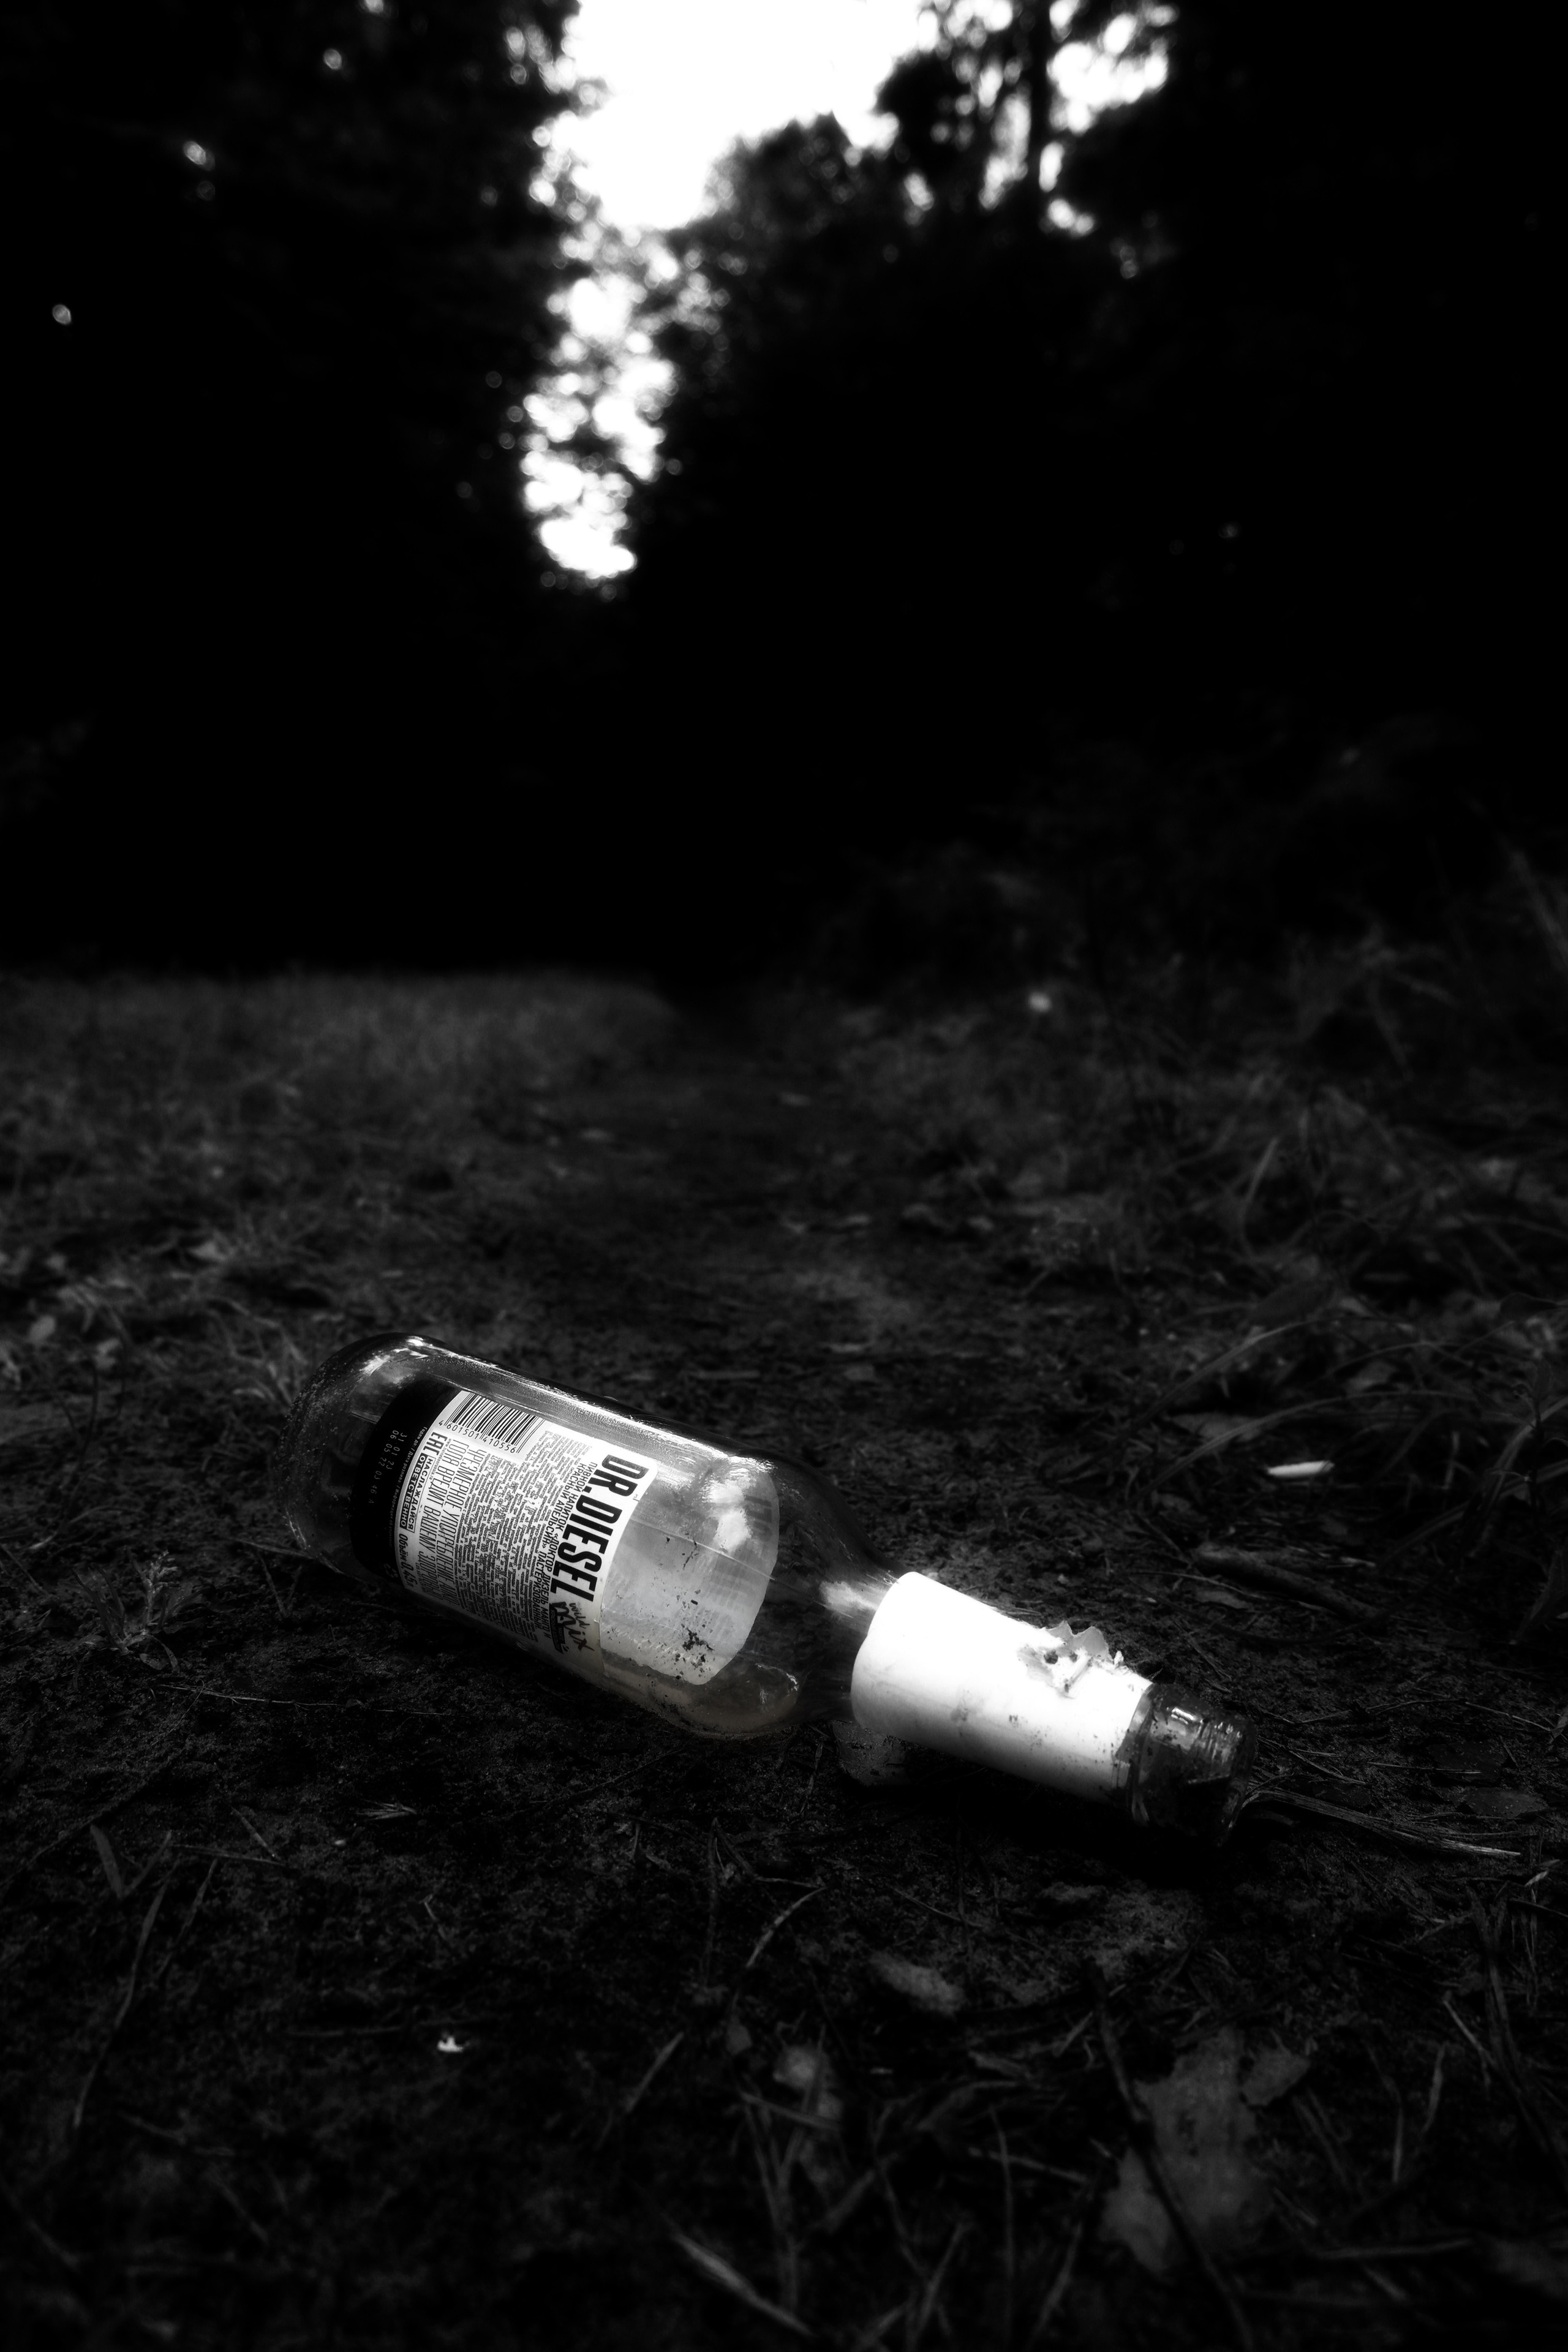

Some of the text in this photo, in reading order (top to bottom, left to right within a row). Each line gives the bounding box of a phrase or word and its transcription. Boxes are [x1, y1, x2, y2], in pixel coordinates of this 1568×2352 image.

[445, 1422, 480, 1440] 601501
[481, 1434, 518, 1454] 410556
[400, 1454, 426, 1527] ОТВЕТСТВЕННО
[407, 1458, 434, 1530] НАСЛАЖДАЙСЯ
[559, 1462, 587, 1499] КРАСНЫЙ
[572, 1461, 600, 1493] ПИВНОЙ
[418, 1439, 469, 1600] ГОЛЯ ВРЕДИТ ВАШЕМУ ЗДОРОВЬЮ
[435, 1445, 486, 1608] ЧРЕЗМЕРНОЕ УПОТРЕБЛЕНИЕ АЛКО-
[540, 1499, 565, 1550] АПЕЛЬСИН»
[555, 1492, 578, 1531] НАПИТОК
[399, 1532, 409, 1562] Объём
[543, 1531, 561, 1572] «ДОКТОР
[532, 1550, 547, 1631] ПАСТЕРИЗОВАННЫЙ.
[539, 1572, 551, 1606] ДИЗЕЛЬ
[540, 1606, 551, 1632] МАНГО
